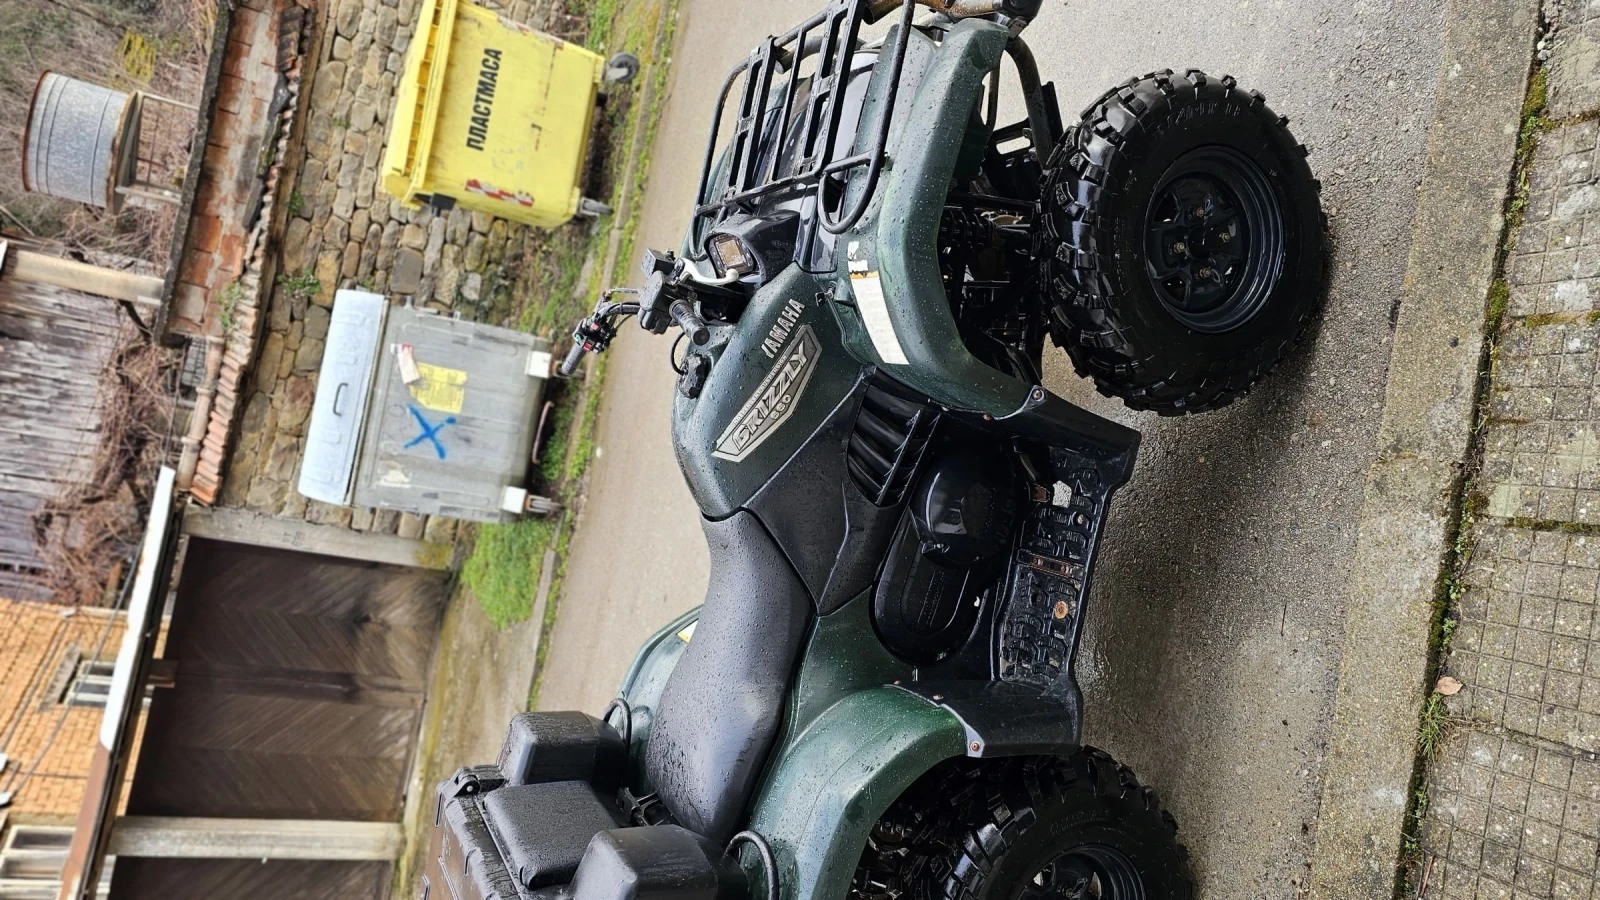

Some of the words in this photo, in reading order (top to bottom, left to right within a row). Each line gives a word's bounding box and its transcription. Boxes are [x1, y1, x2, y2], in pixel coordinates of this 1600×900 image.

[466, 48, 502, 151] ПЛАСТМАСА
[761, 299, 805, 358] YAMAHA
[733, 340, 808, 450] GRIZZLY
[770, 394, 791, 420] 660
